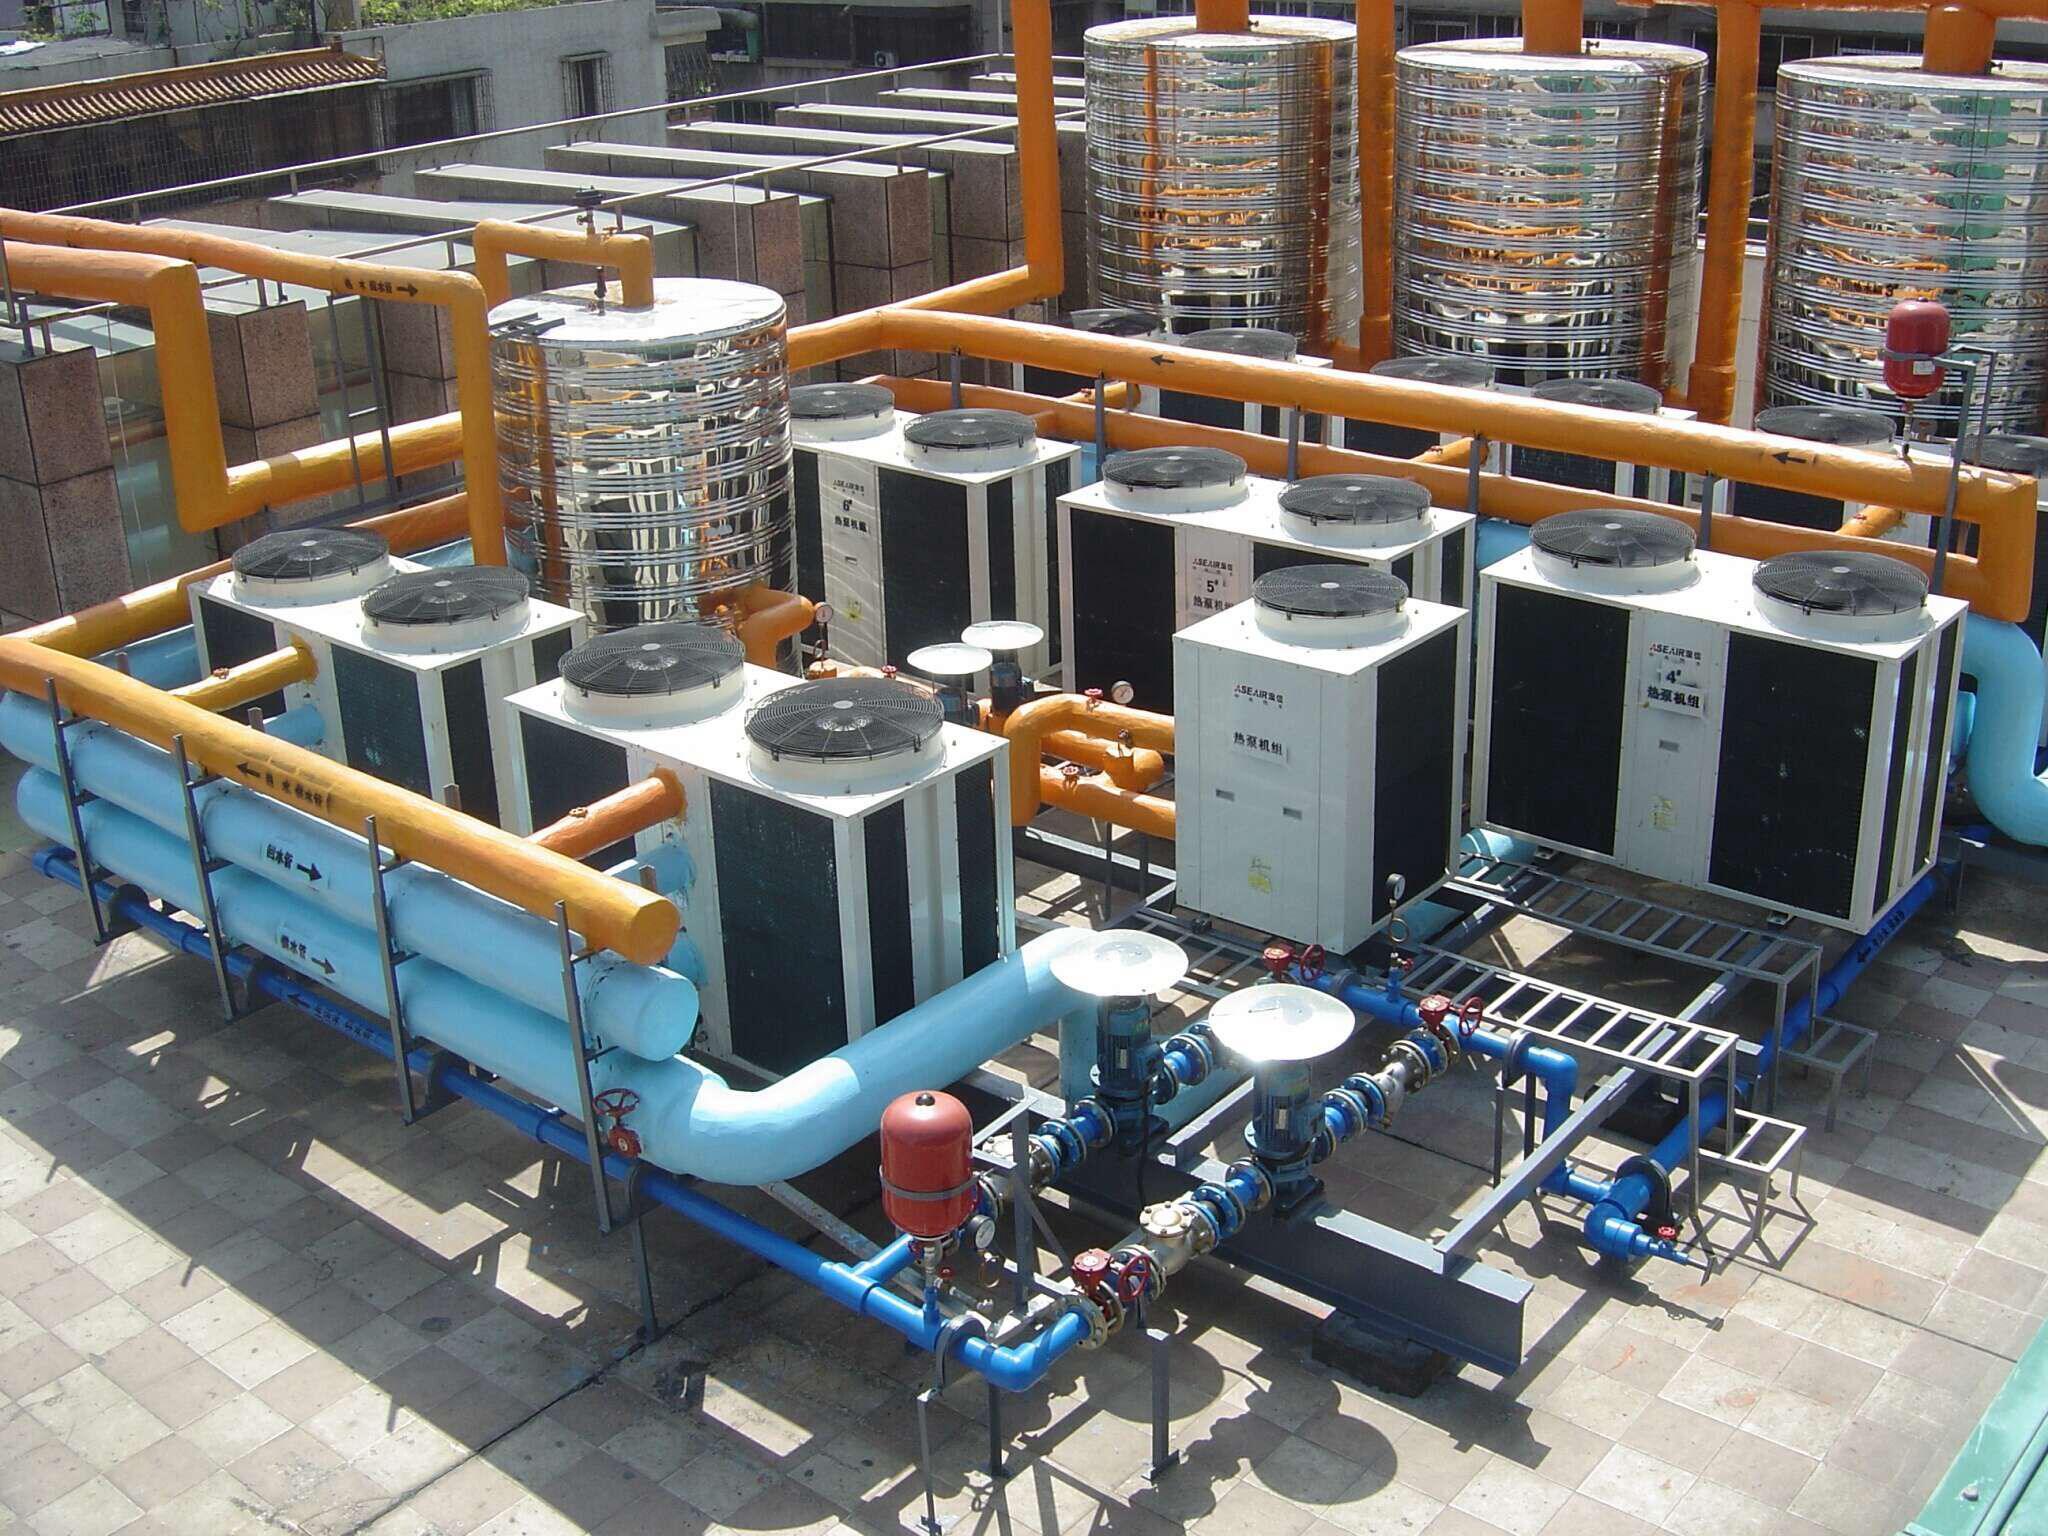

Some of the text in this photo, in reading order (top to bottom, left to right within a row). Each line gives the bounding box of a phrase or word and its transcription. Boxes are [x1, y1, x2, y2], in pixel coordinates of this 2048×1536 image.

[1650, 643, 1686, 658] ASEAIR
[1233, 684, 1269, 700] ASEAIR
[1647, 684, 1701, 709] 热泵机组
[1233, 731, 1283, 756] 热泵机组
[266, 843, 294, 870] 回水管
